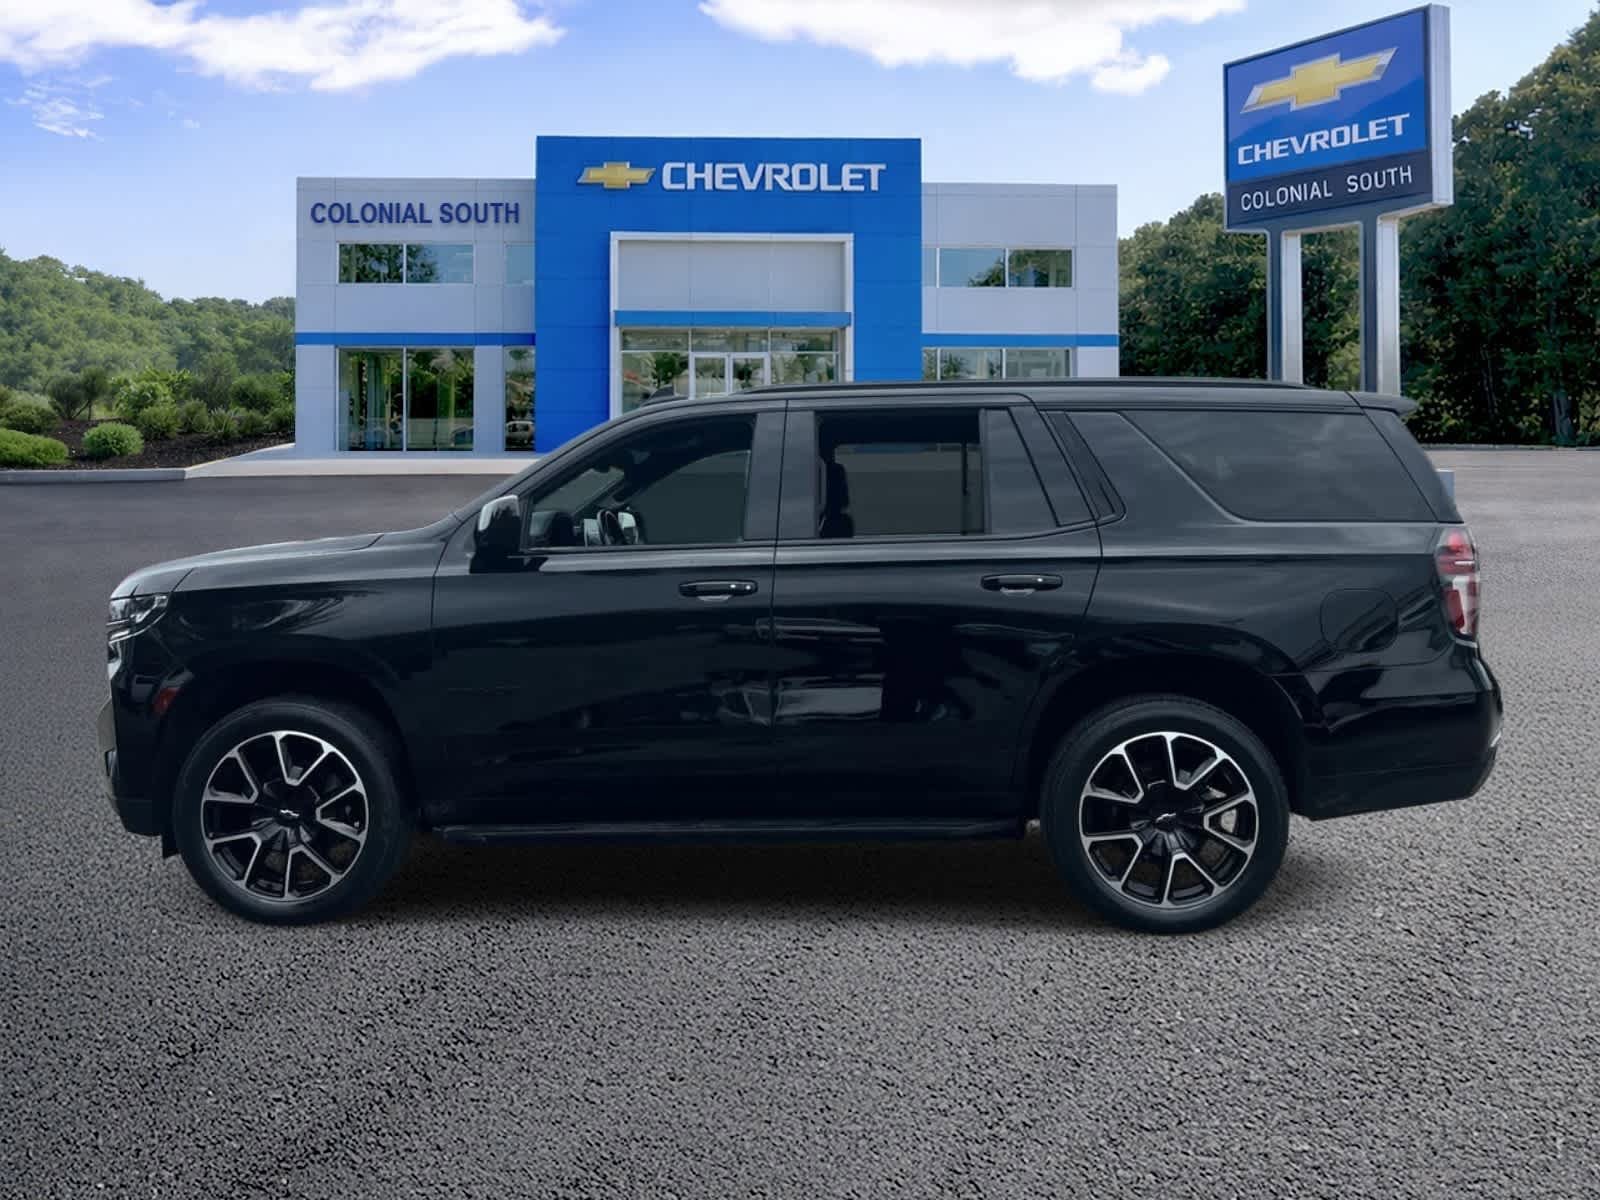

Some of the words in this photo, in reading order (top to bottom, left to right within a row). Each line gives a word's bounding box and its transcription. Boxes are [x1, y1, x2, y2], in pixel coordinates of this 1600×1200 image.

[1237, 113, 1410, 165] CHEVROLET
[661, 162, 886, 192] CHEVROLET
[1240, 180, 1333, 211] COLONIAL
[1346, 165, 1413, 194] SOUTH
[310, 202, 433, 224] COLONIAL
[439, 202, 520, 224] SOUTH
